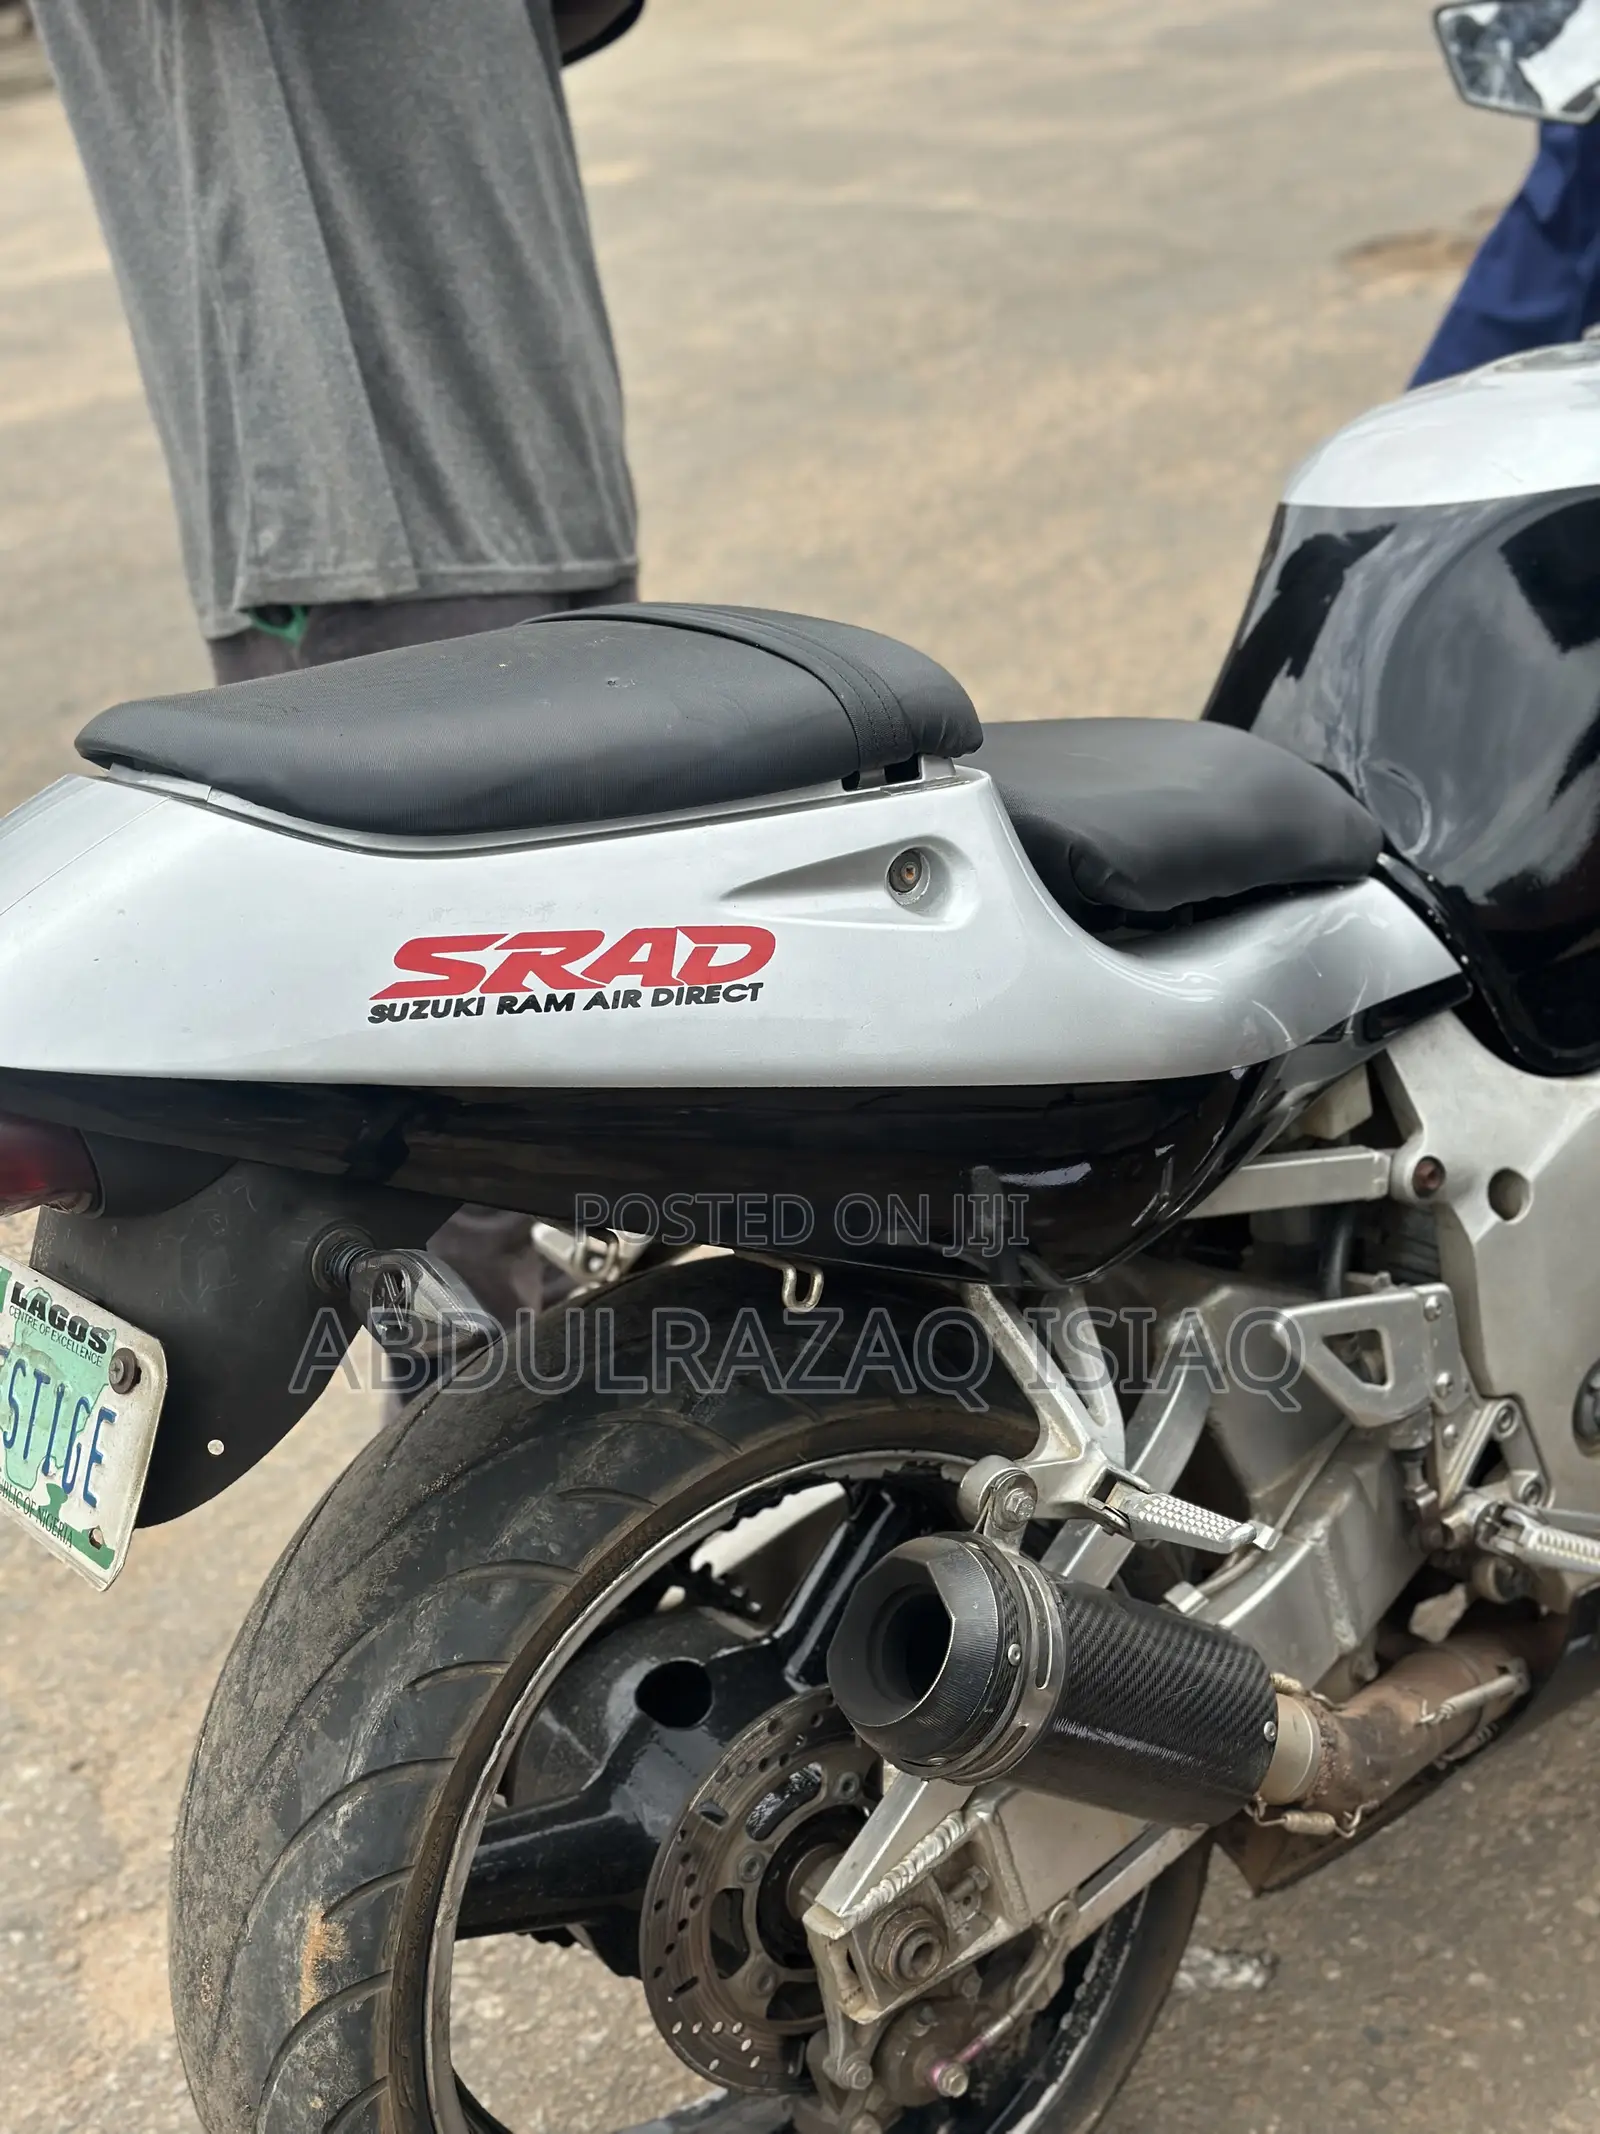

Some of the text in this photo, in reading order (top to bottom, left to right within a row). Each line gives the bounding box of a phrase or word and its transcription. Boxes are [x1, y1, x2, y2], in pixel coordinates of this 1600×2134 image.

[369, 925, 776, 1000] SRAD
[367, 982, 765, 1024] SUZUKI RAM AIR DIRECT
[9, 1305, 104, 1367] CENTRE OF EXCELLENCE
[10, 1281, 111, 1355] LAGOS
[0, 1346, 118, 1509] STIGE
[0, 1480, 74, 1548] BLIC OF NIGERIA
